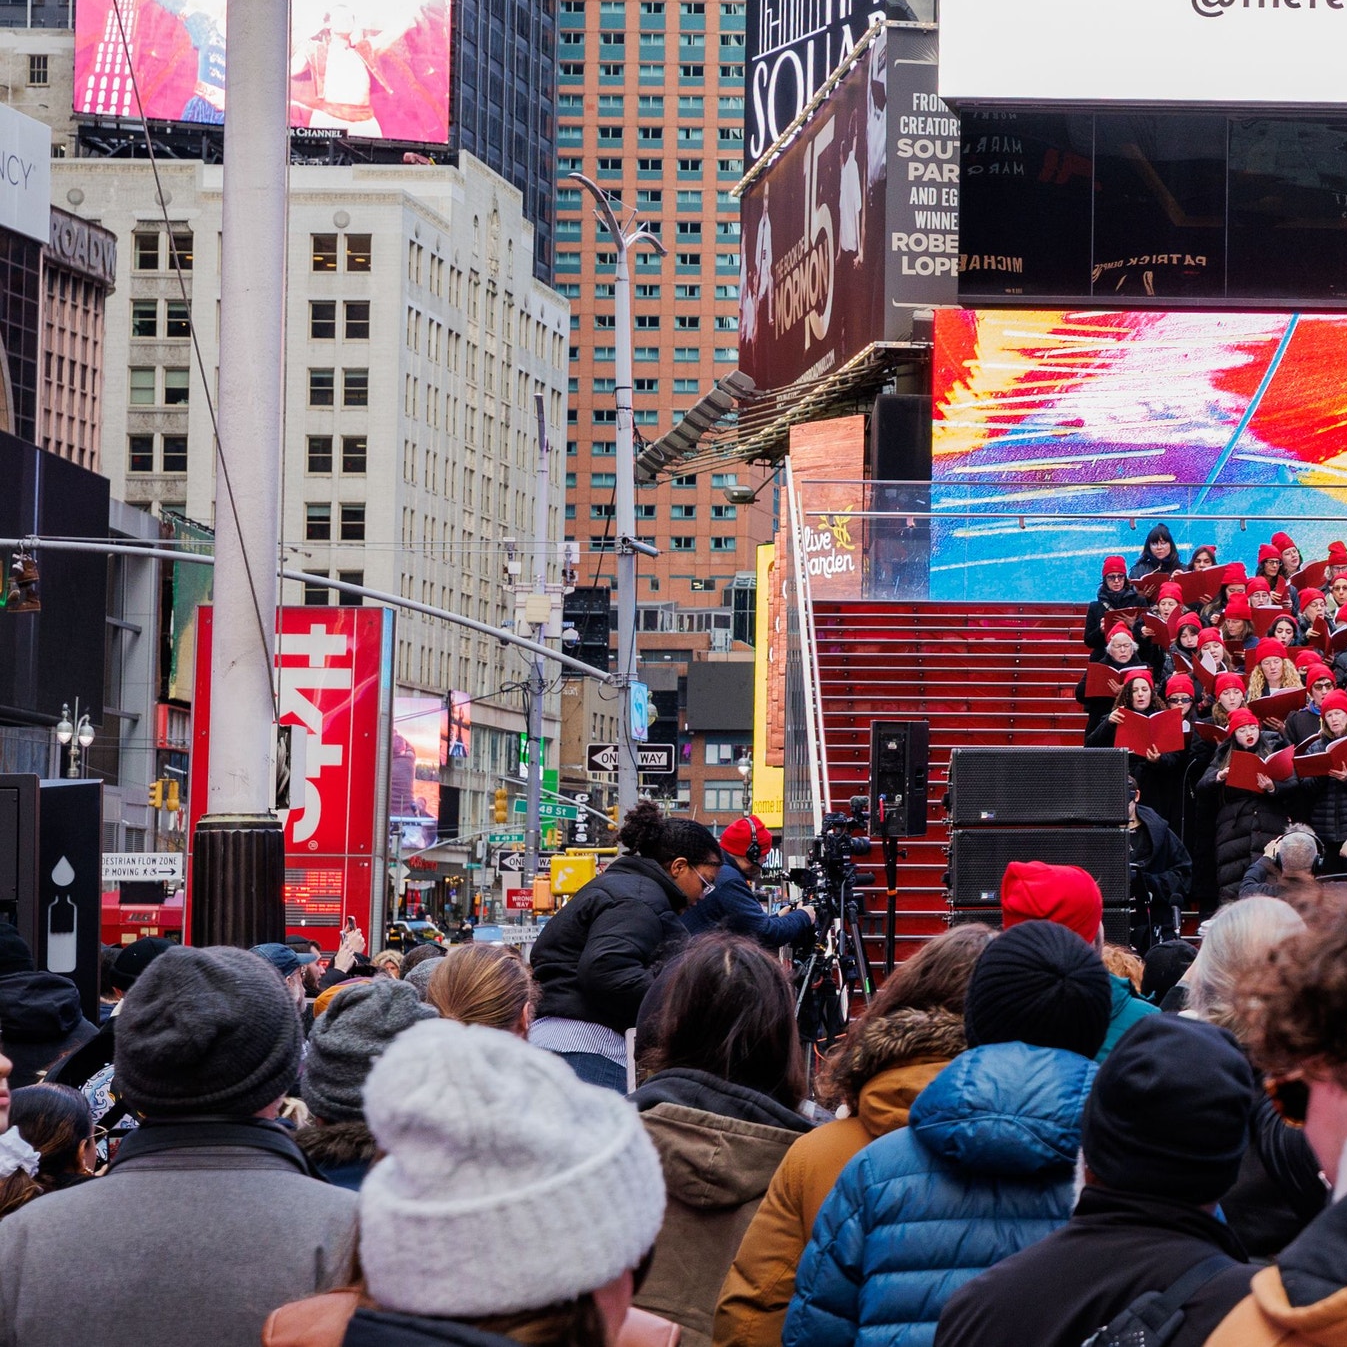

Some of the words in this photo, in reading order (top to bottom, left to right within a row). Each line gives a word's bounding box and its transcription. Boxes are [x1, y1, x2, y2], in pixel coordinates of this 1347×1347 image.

[296, 127, 343, 138] CHANNEL
[909, 186, 937, 206] AND
[775, 238, 829, 341] MORMON
[804, 525, 832, 552] live
[806, 548, 856, 579] arden
[601, 753, 619, 764] ON
[640, 754, 664, 764] WAY
[540, 805, 553, 814] 48
[555, 806, 567, 816] St
[753, 800, 774, 813] come
[138, 857, 157, 865] FLOW
[159, 857, 177, 865] ZONE
[112, 867, 139, 876] MOVING
